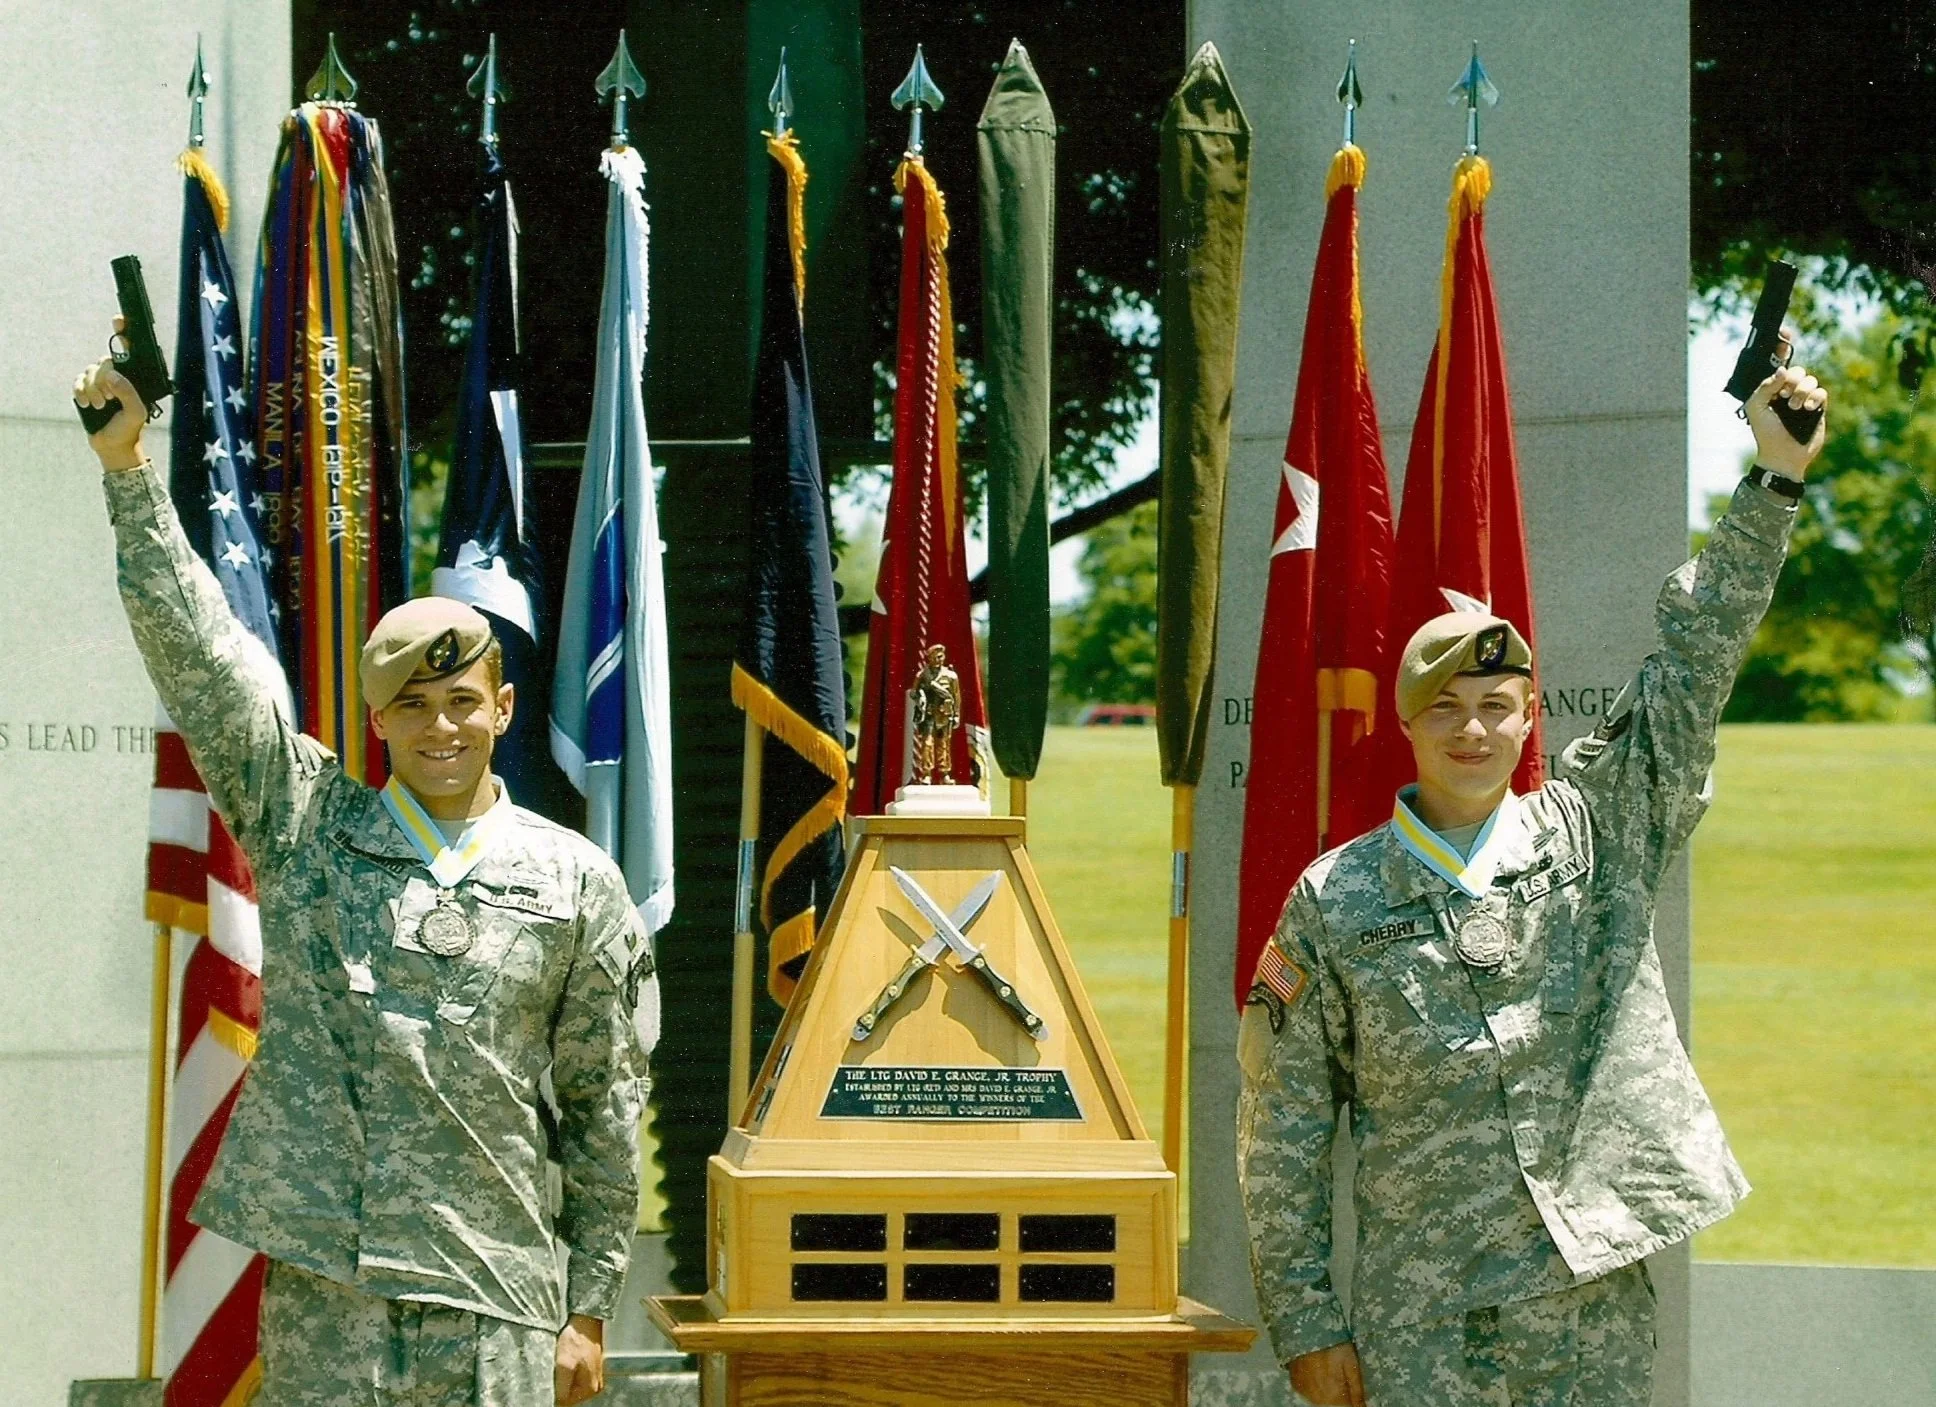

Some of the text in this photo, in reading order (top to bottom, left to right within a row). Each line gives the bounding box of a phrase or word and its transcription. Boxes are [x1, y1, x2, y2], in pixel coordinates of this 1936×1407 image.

[319, 336, 341, 426] MEXICO
[263, 382, 283, 471] MANILA
[26, 723, 96, 752] LEAD
[1519, 857, 1581, 897] U.S. ARMY
[517, 897, 552, 913] ARMY
[1360, 920, 1416, 946] CHERRY
[845, 1070, 867, 1080] THE
[870, 1070, 891, 1081] LTG
[894, 1070, 928, 1081] DAVID
[1015, 1072, 1057, 1083] TROPHY
[858, 1093, 1045, 1103] AWARDED ANNUALLY TO THE WINNERS OF THE
[873, 1104, 1031, 1116] BEST RANGER COMPETITION
